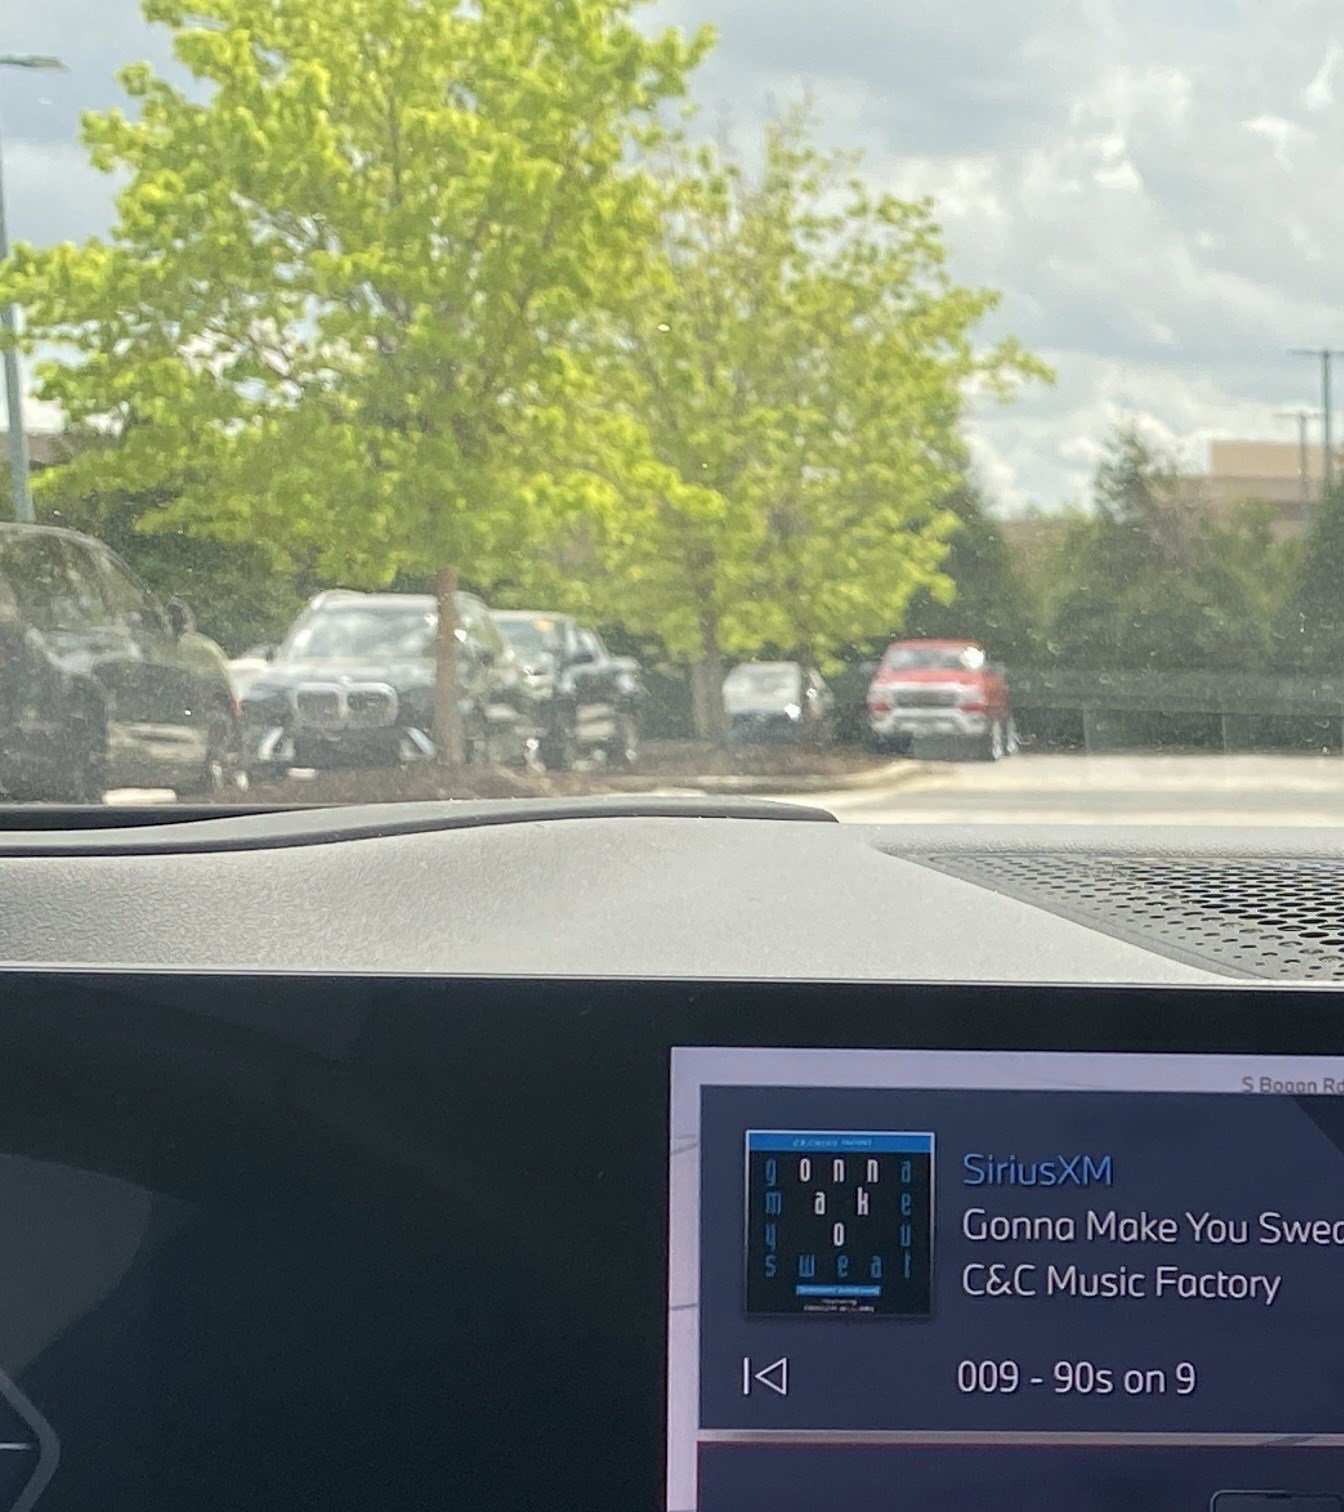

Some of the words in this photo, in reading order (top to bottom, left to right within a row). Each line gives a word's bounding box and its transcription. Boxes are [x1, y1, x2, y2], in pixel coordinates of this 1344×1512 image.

[962, 1153, 1113, 1187] SiriusXM
[962, 1207, 1076, 1242] Gonna
[1086, 1210, 1178, 1243] Make
[1185, 1211, 1248, 1244] You
[962, 1263, 1036, 1297] C&C
[1047, 1265, 1145, 1298] Music
[1156, 1266, 1282, 1305] Factory
[957, 1360, 1019, 1393] 009
[1053, 1361, 1114, 1393] 90s
[1123, 1368, 1166, 1394] on
[1175, 1361, 1196, 1394] 9
